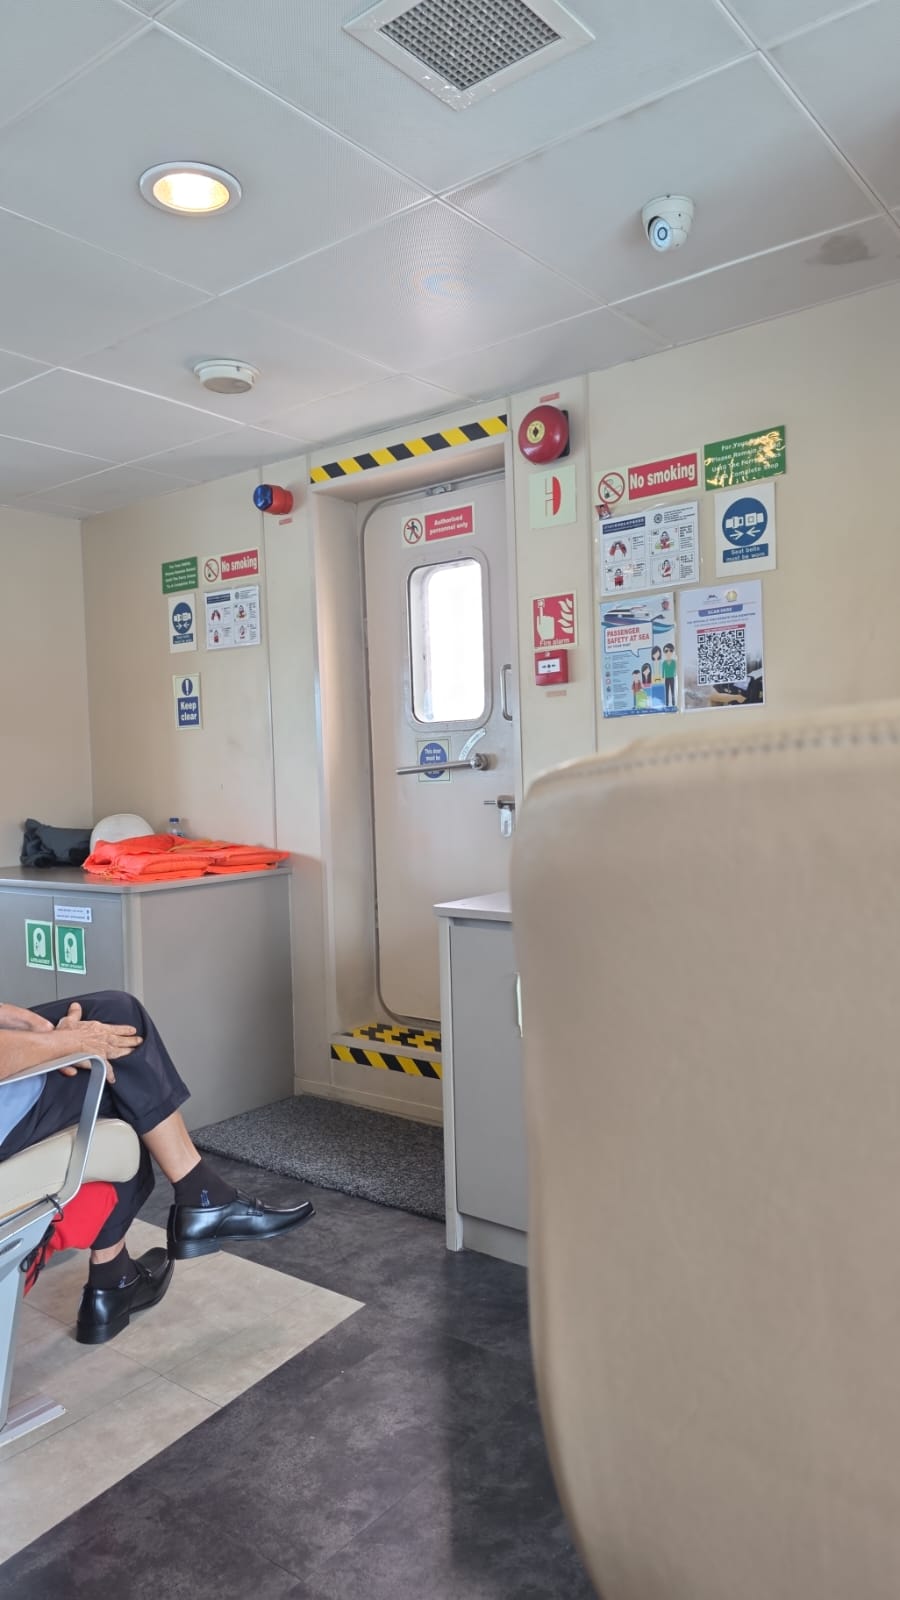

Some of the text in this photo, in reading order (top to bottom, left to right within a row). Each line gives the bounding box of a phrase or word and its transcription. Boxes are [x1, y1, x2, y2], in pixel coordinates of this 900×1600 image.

[629, 473, 645, 490] No
[647, 462, 695, 486] smoking
[430, 521, 469, 536] personnel only
[745, 545, 760, 553] belts
[222, 556, 258, 573] No smoking
[607, 627, 640, 637] PASSENGER
[607, 636, 629, 645] SAFETY
[180, 701, 197, 712] Keep
[181, 711, 198, 721] clear
